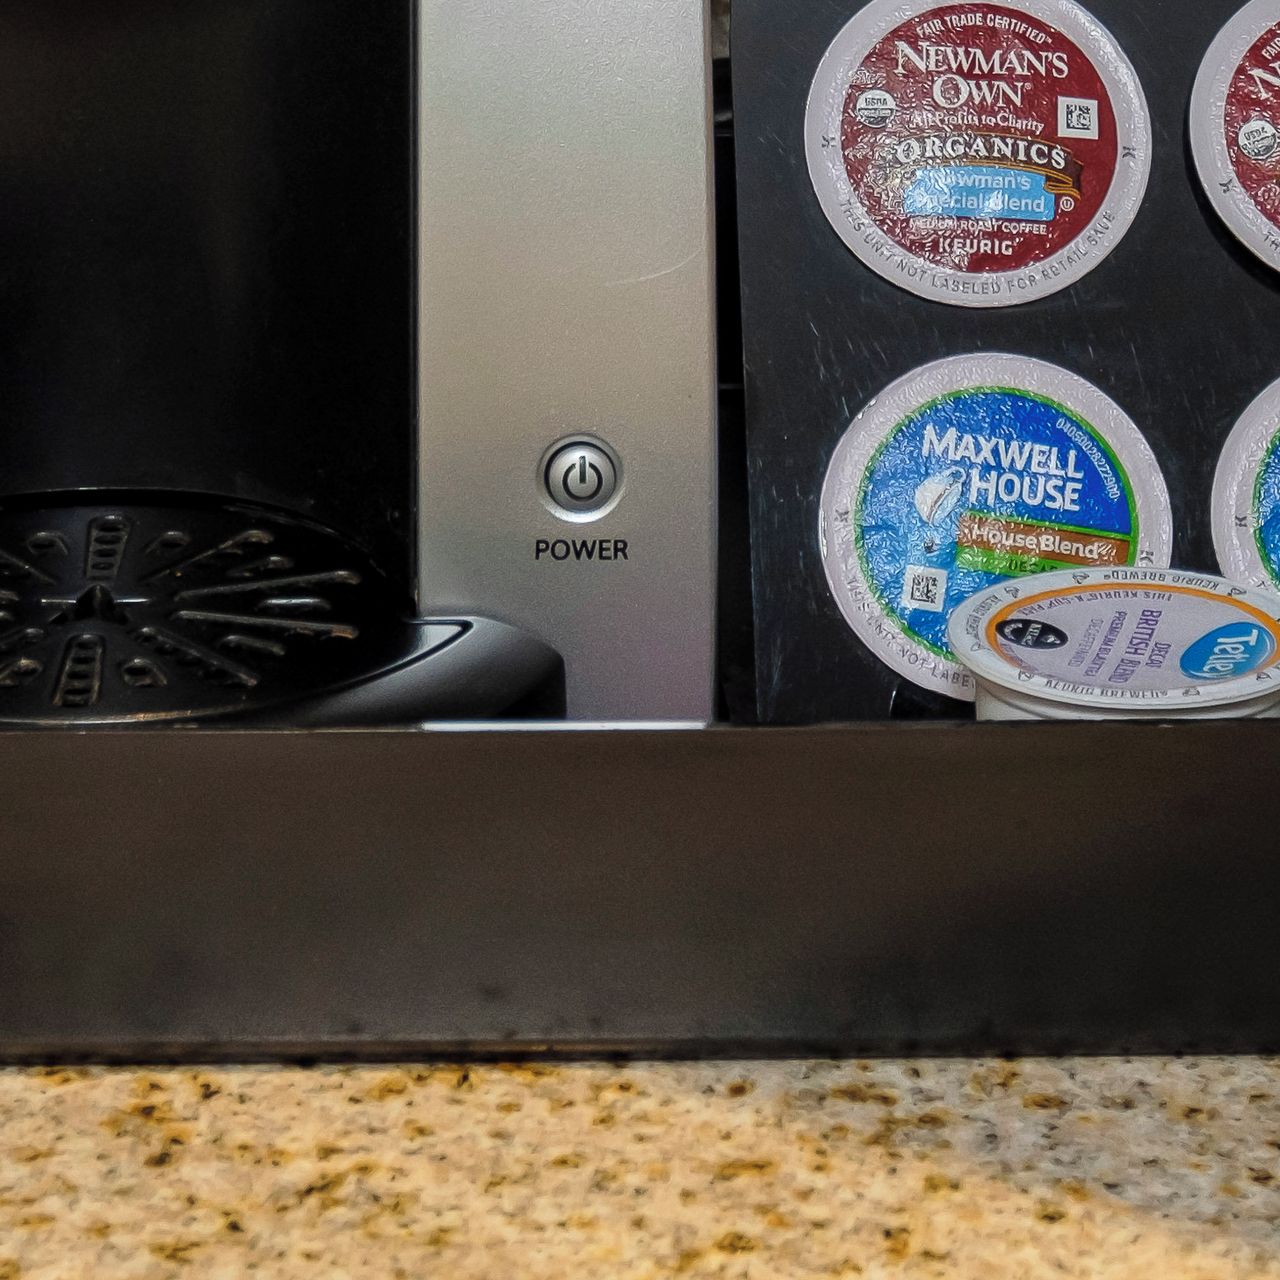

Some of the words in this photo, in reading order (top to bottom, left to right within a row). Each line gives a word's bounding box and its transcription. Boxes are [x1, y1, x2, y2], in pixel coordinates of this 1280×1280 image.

[916, 18, 945, 38] FAIR
[945, 13, 984, 29] TRADE
[893, 40, 1070, 79] NEWMAN'S
[996, 112, 1045, 134] Charity
[895, 134, 1067, 170] ORGANICS
[987, 189, 1045, 213] lend
[959, 218, 999, 235] ROAST
[1002, 221, 1048, 236] COFFEE
[938, 237, 1014, 256] KEURIG
[895, 259, 928, 283] NOT
[1008, 274, 1039, 293] FOR
[921, 421, 1085, 480] MAXWELL
[969, 465, 1084, 512] HOUSE
[534, 538, 630, 561] POWER
[970, 523, 1038, 551] House
[1039, 534, 1100, 560] Blend
[1171, 575, 1221, 592] KEURIG
[1125, 608, 1163, 657] BRITISH
